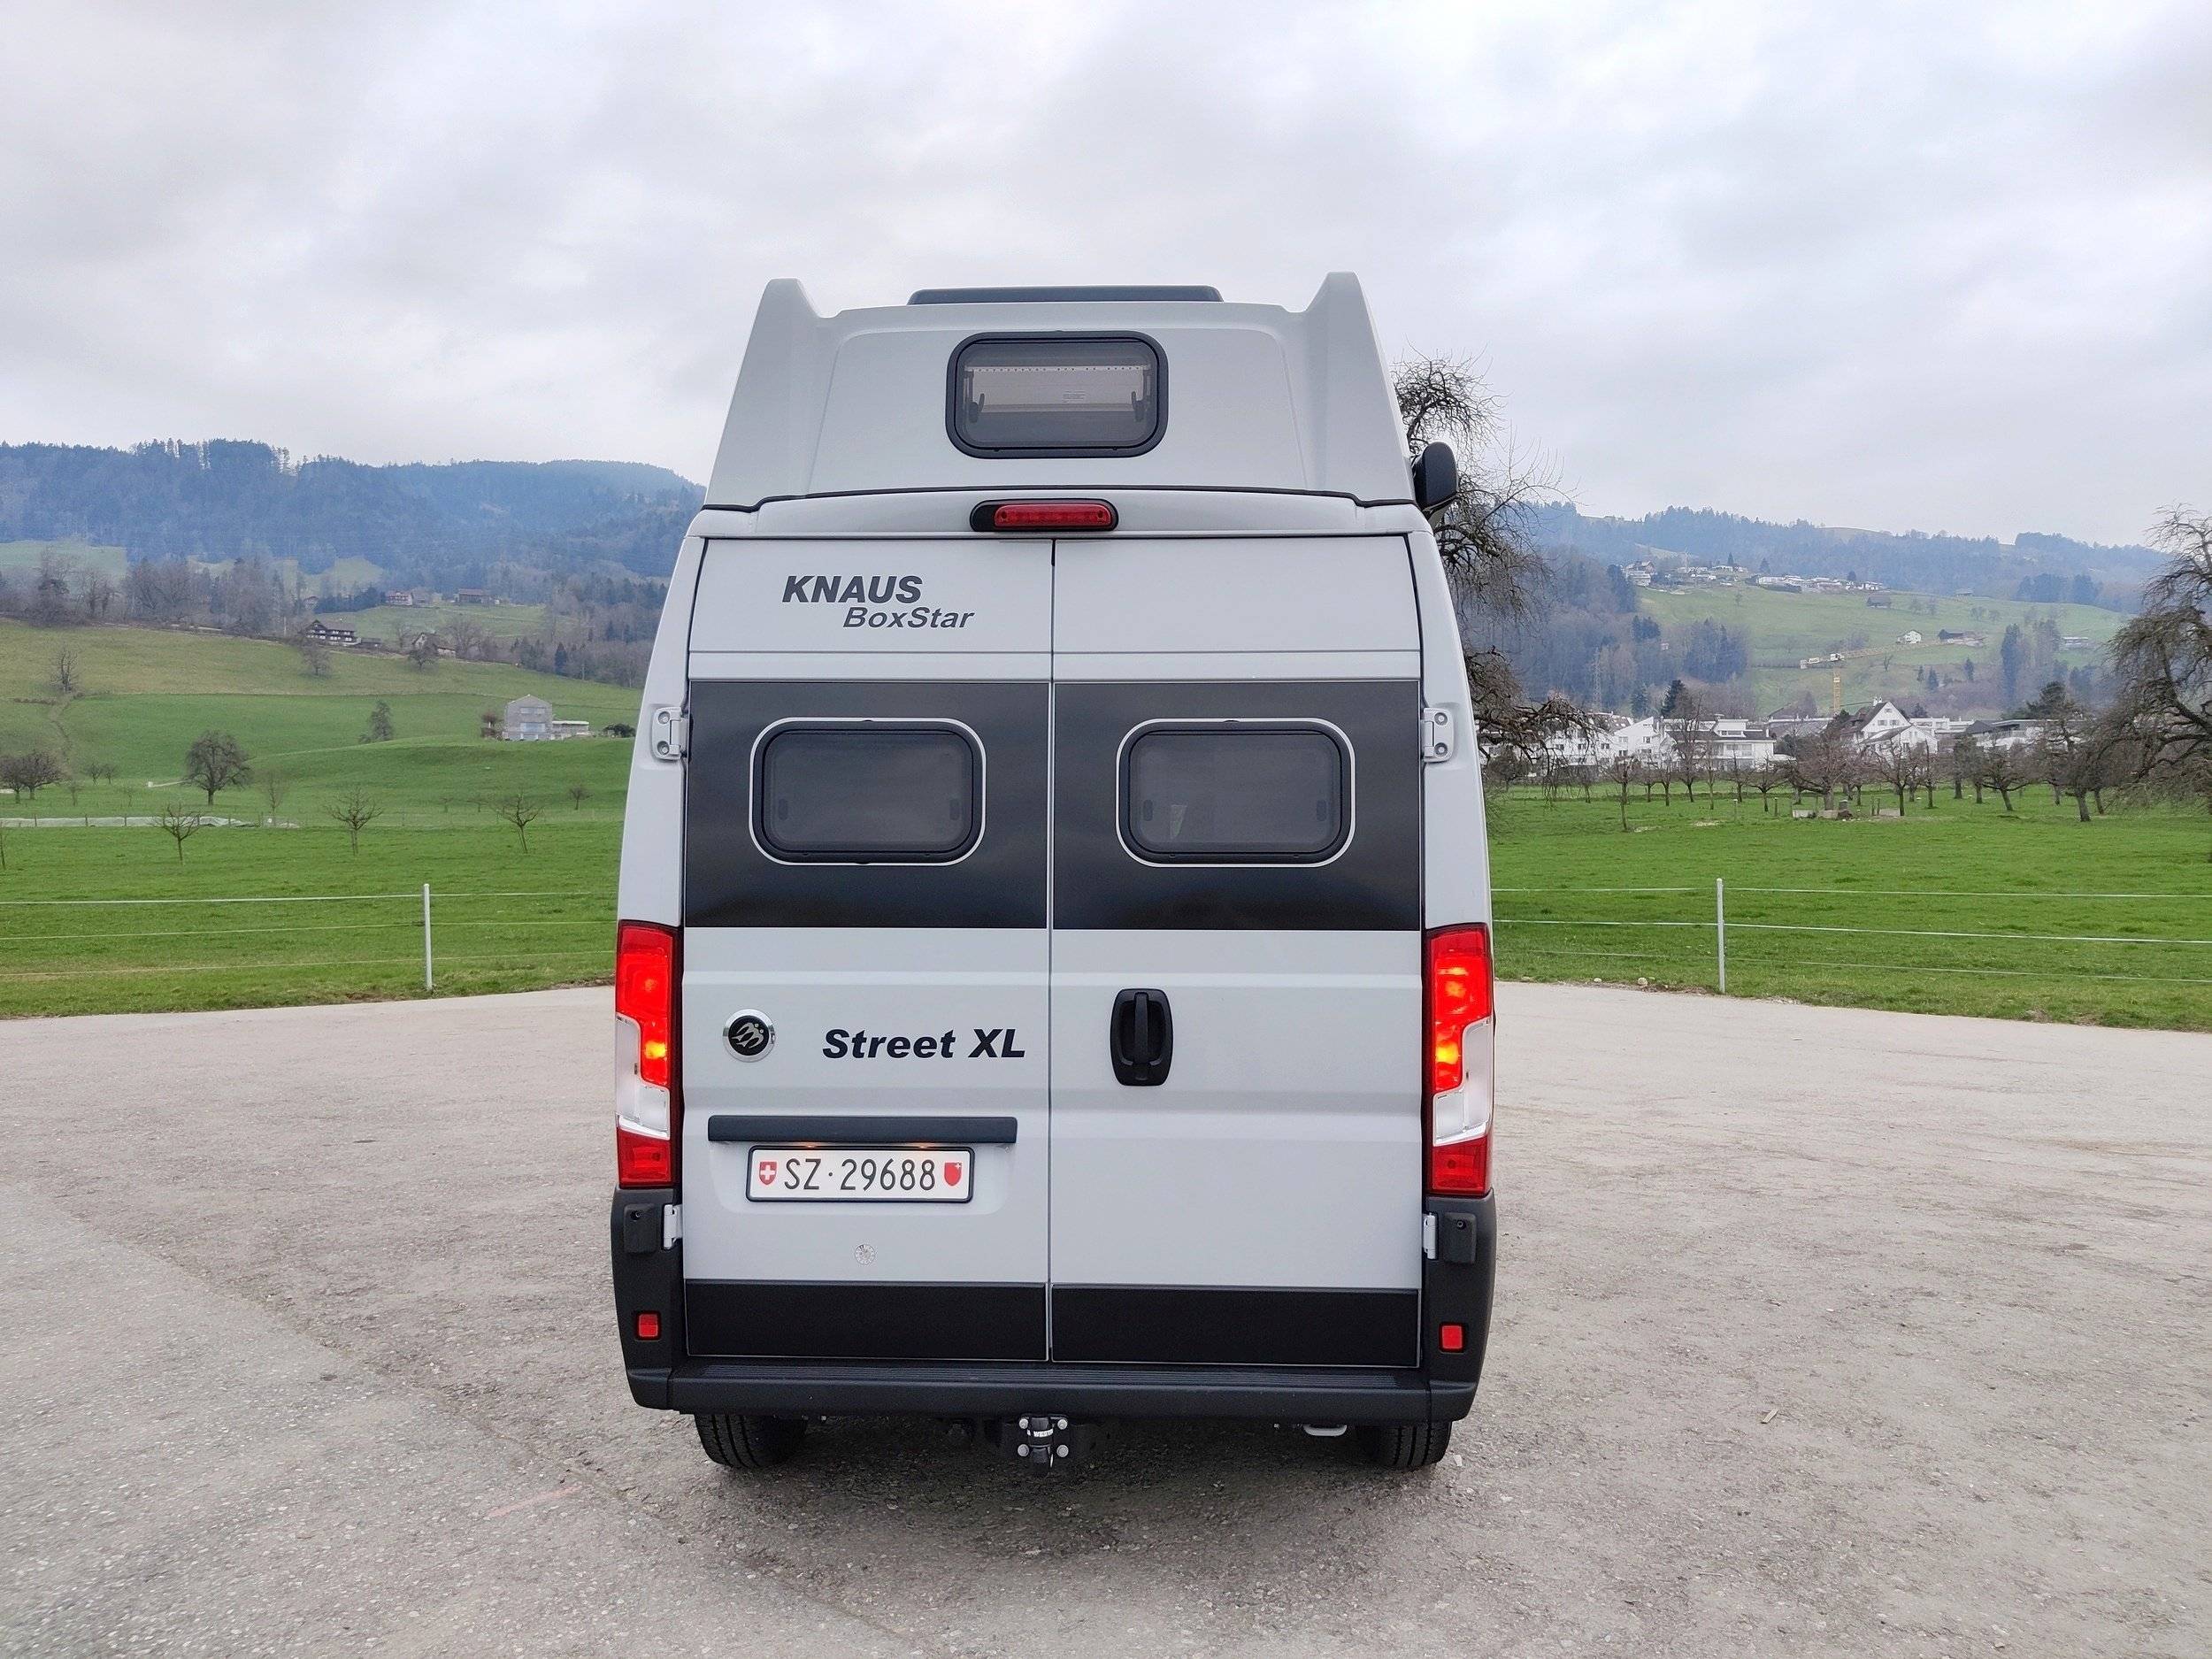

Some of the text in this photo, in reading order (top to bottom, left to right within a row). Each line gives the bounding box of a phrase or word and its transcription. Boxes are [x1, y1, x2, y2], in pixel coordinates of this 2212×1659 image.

[781, 575, 923, 604] KNAUS
[842, 607, 975, 628] BoxStar
[822, 1028, 1025, 1059] Street XL
